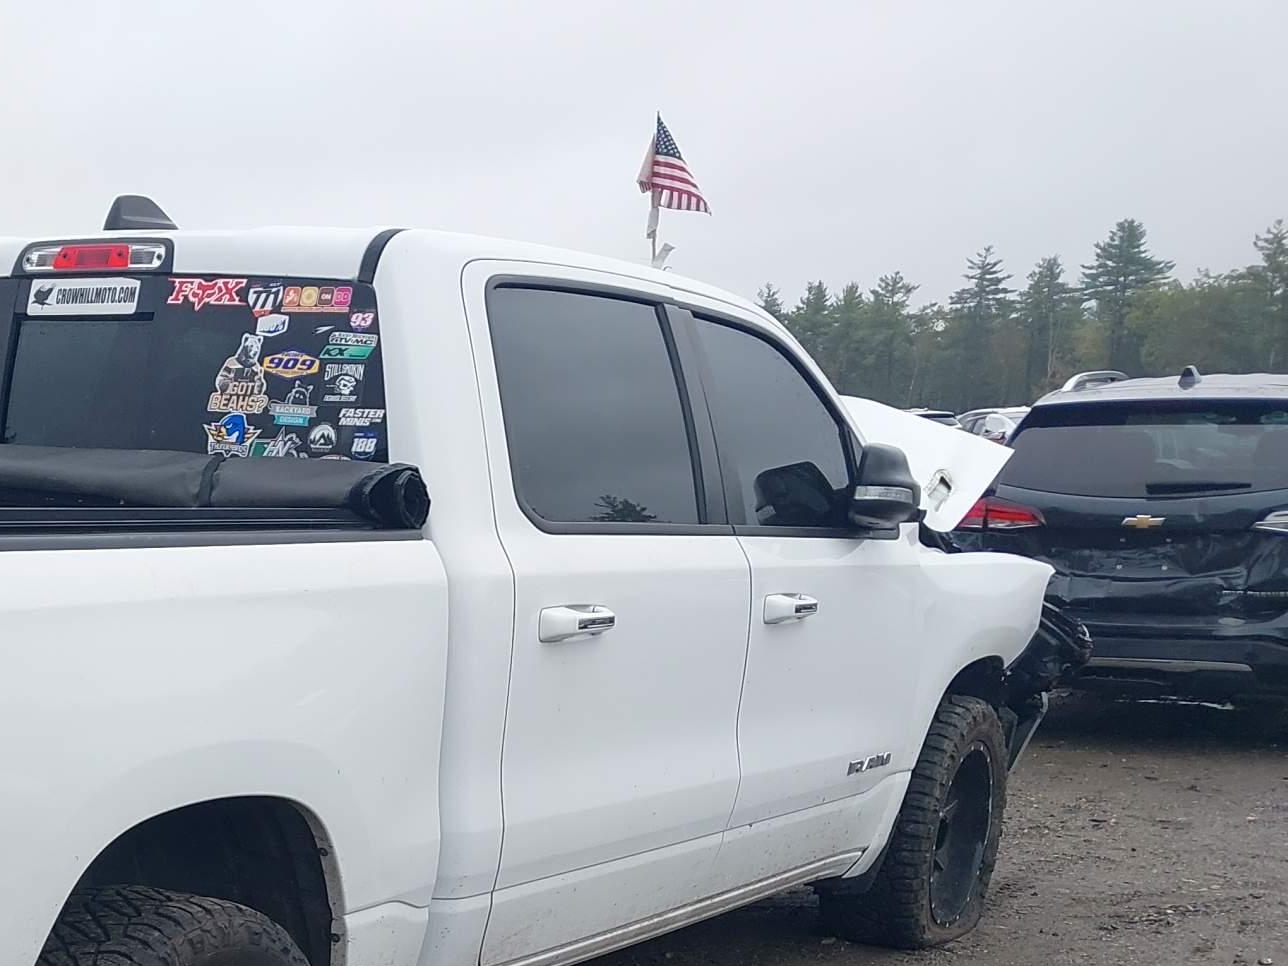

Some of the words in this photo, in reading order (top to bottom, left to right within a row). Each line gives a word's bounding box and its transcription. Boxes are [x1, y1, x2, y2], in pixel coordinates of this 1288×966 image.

[55, 286, 138, 305] CROWHILLMOTO.COM
[167, 278, 248, 312] FOX
[349, 312, 374, 327] 93
[322, 346, 349, 357] KX
[266, 357, 316, 371] 909
[229, 382, 255, 395] GOT
[211, 394, 268, 413] BEAHS?
[338, 407, 386, 418] FASTER
[338, 417, 371, 427] MINIS
[846, 751, 892, 777] RAM
